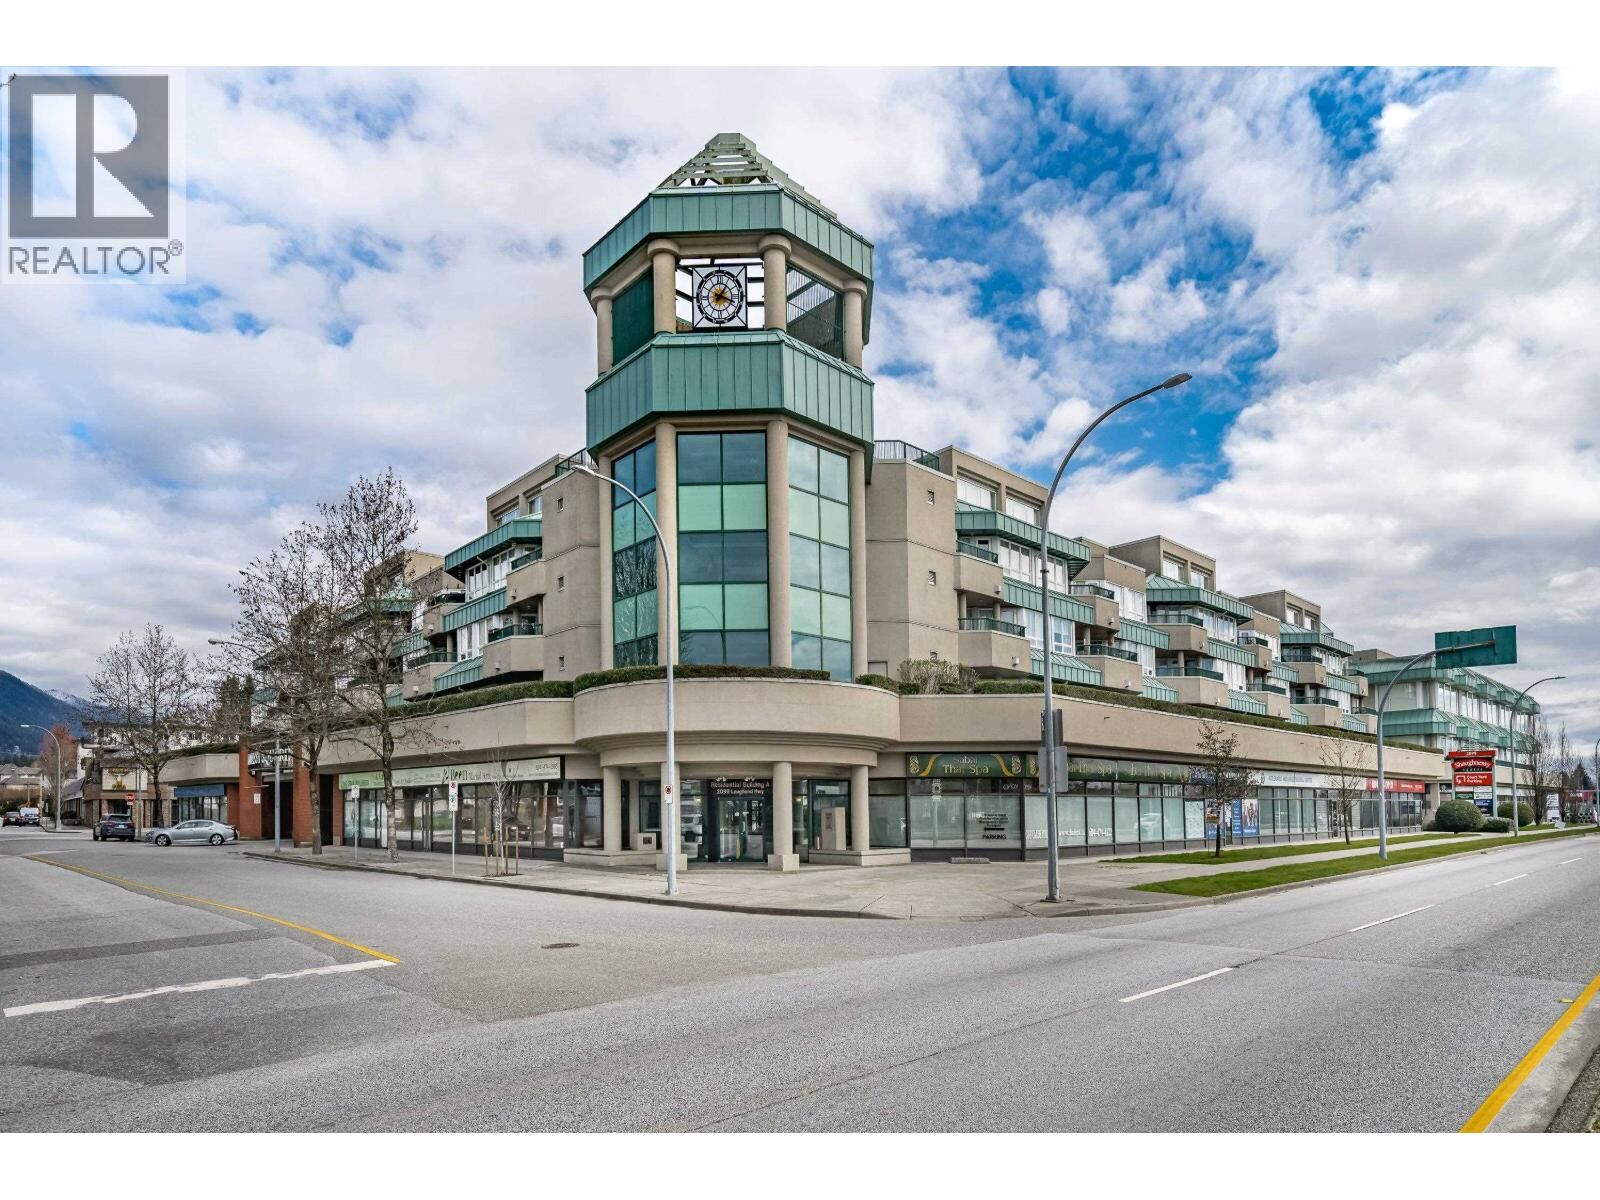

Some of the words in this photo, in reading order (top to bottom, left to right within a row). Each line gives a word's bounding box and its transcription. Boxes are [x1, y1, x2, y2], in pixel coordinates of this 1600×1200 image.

[943, 764, 965, 774] Thai
[970, 763, 989, 775] Spa
[743, 781, 765, 789] Building
